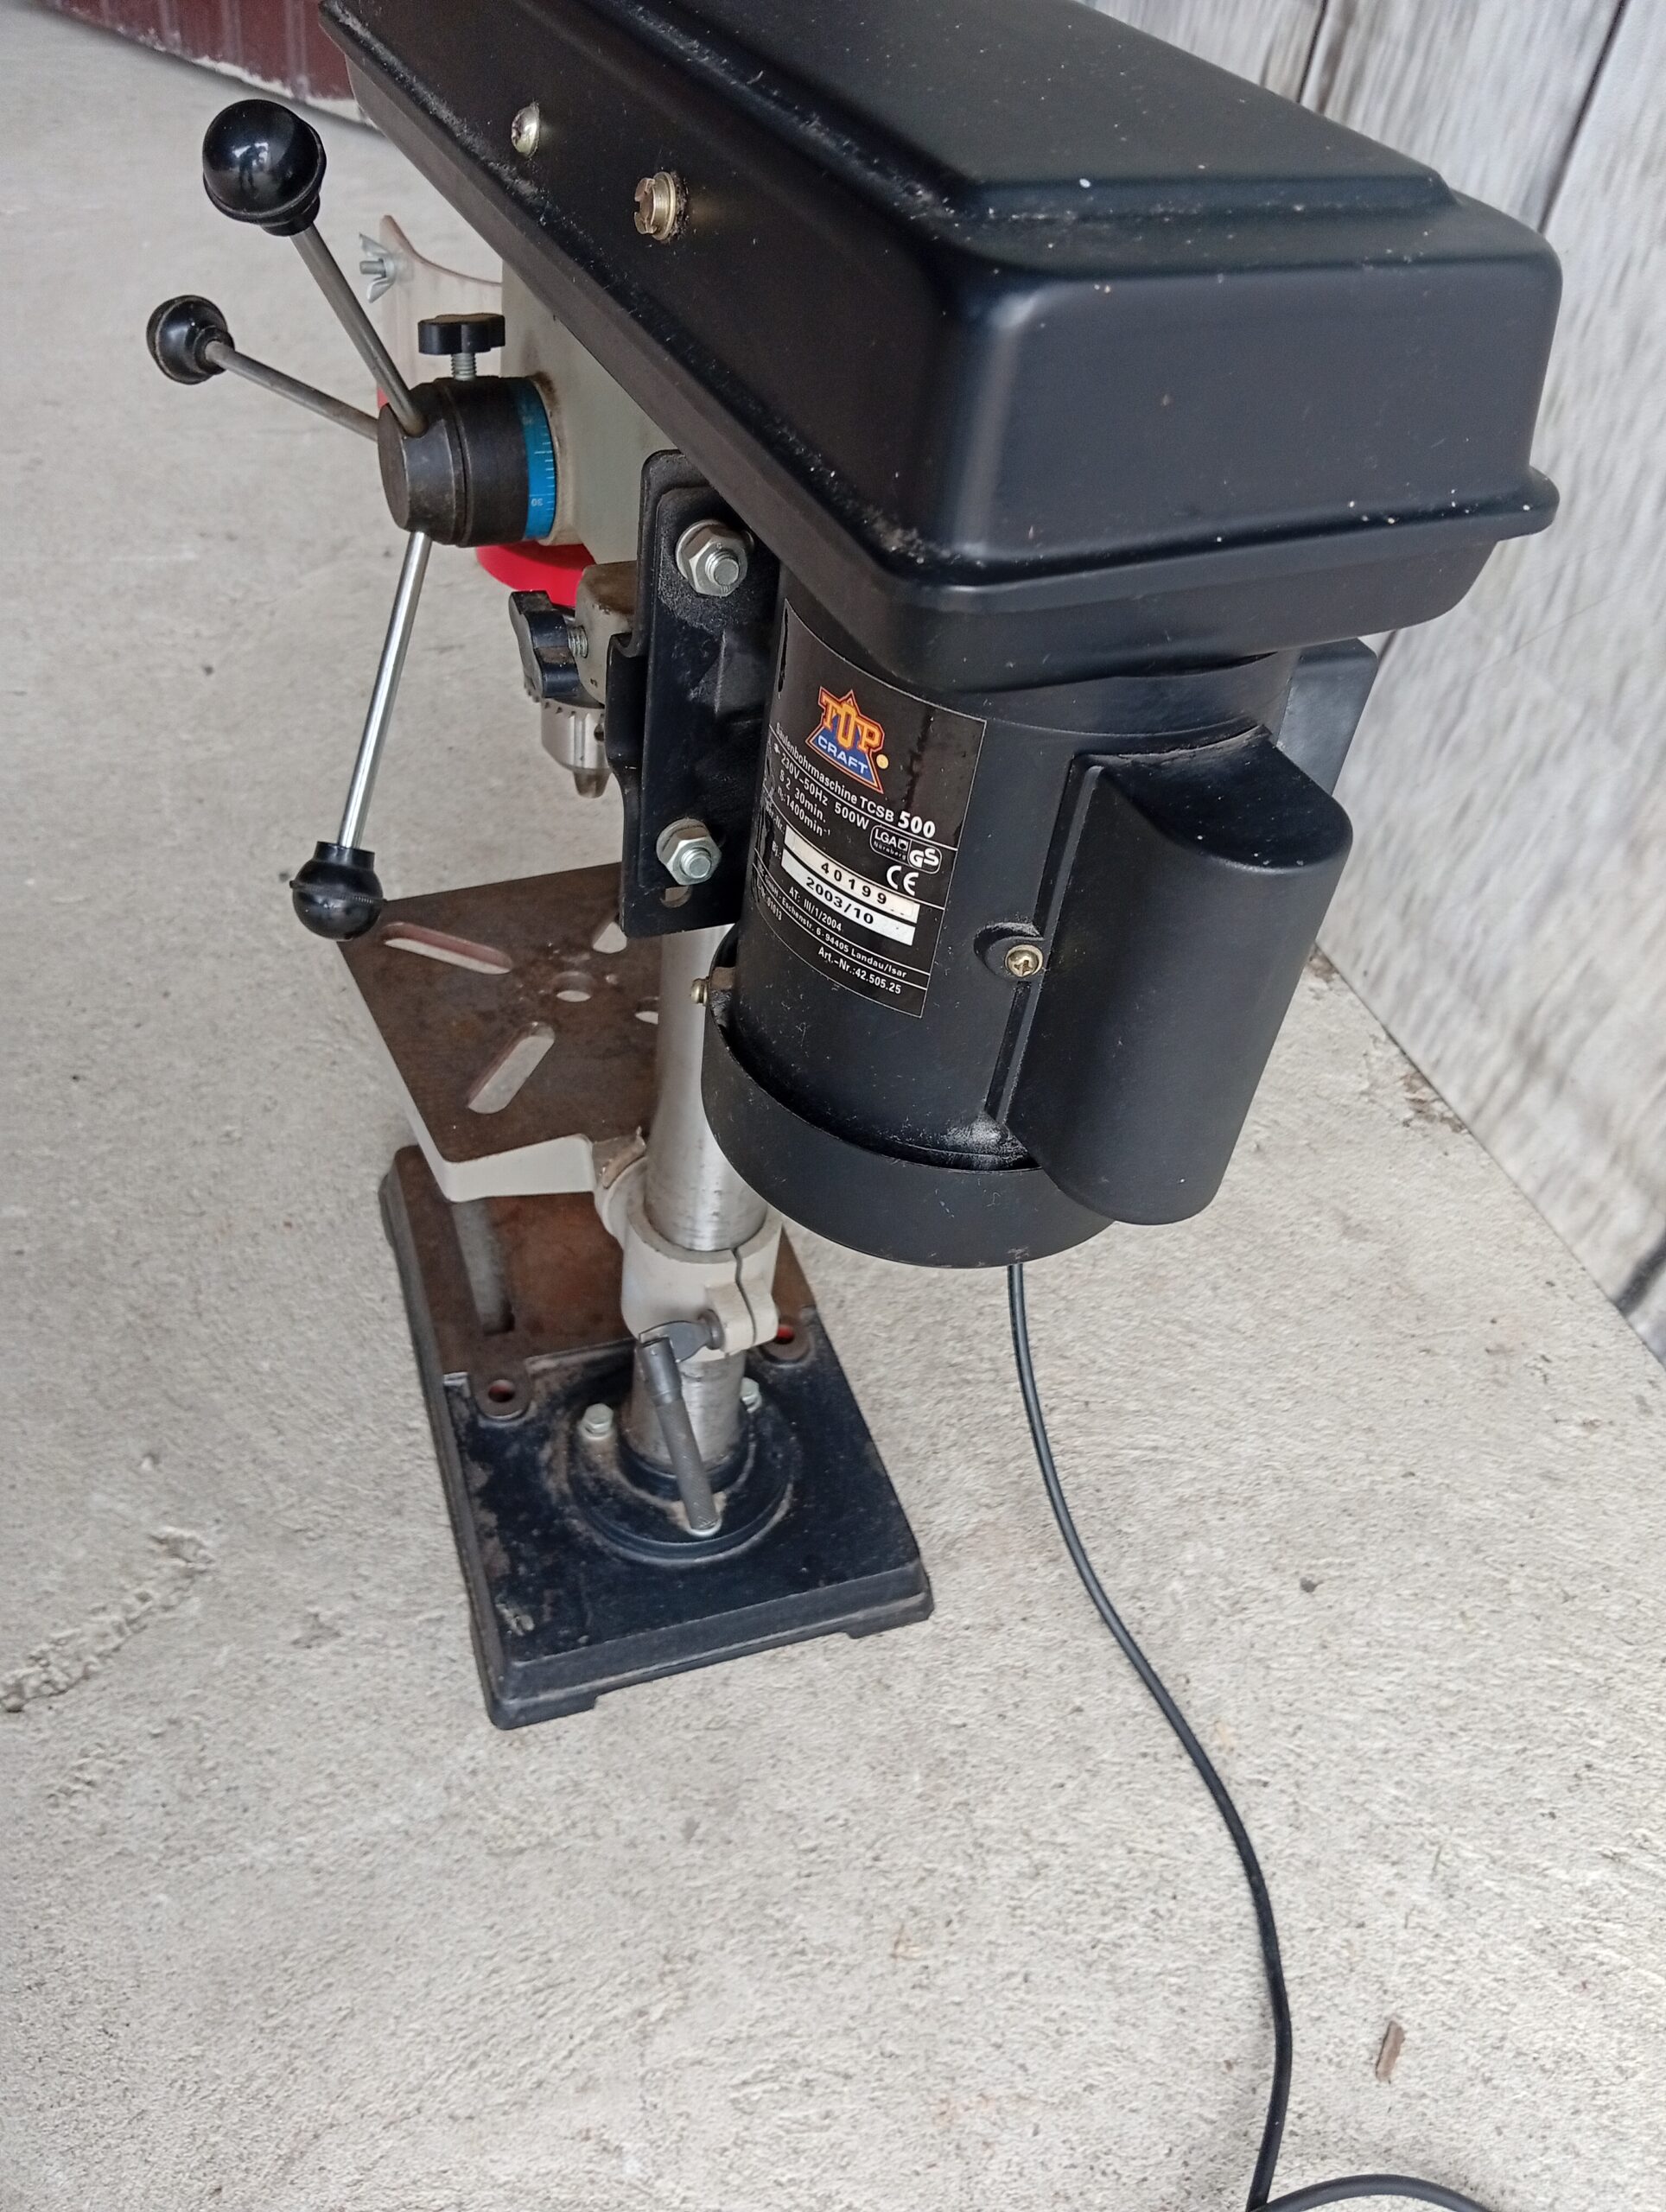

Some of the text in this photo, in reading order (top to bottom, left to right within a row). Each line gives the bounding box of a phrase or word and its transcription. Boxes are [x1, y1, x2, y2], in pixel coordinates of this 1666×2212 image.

[821, 692, 882, 753] TOP
[817, 734, 868, 774] CRAFT
[794, 787, 826, 823] 30min.
[834, 802, 869, 830] 500W
[860, 796, 894, 823] TCSB
[897, 810, 936, 839] 500
[874, 829, 939, 868] LGA GS
[805, 876, 874, 925] 2003/10
[821, 862, 887, 905] 40199
[887, 865, 919, 897] CE
[851, 948, 907, 978] Landau/Isar
